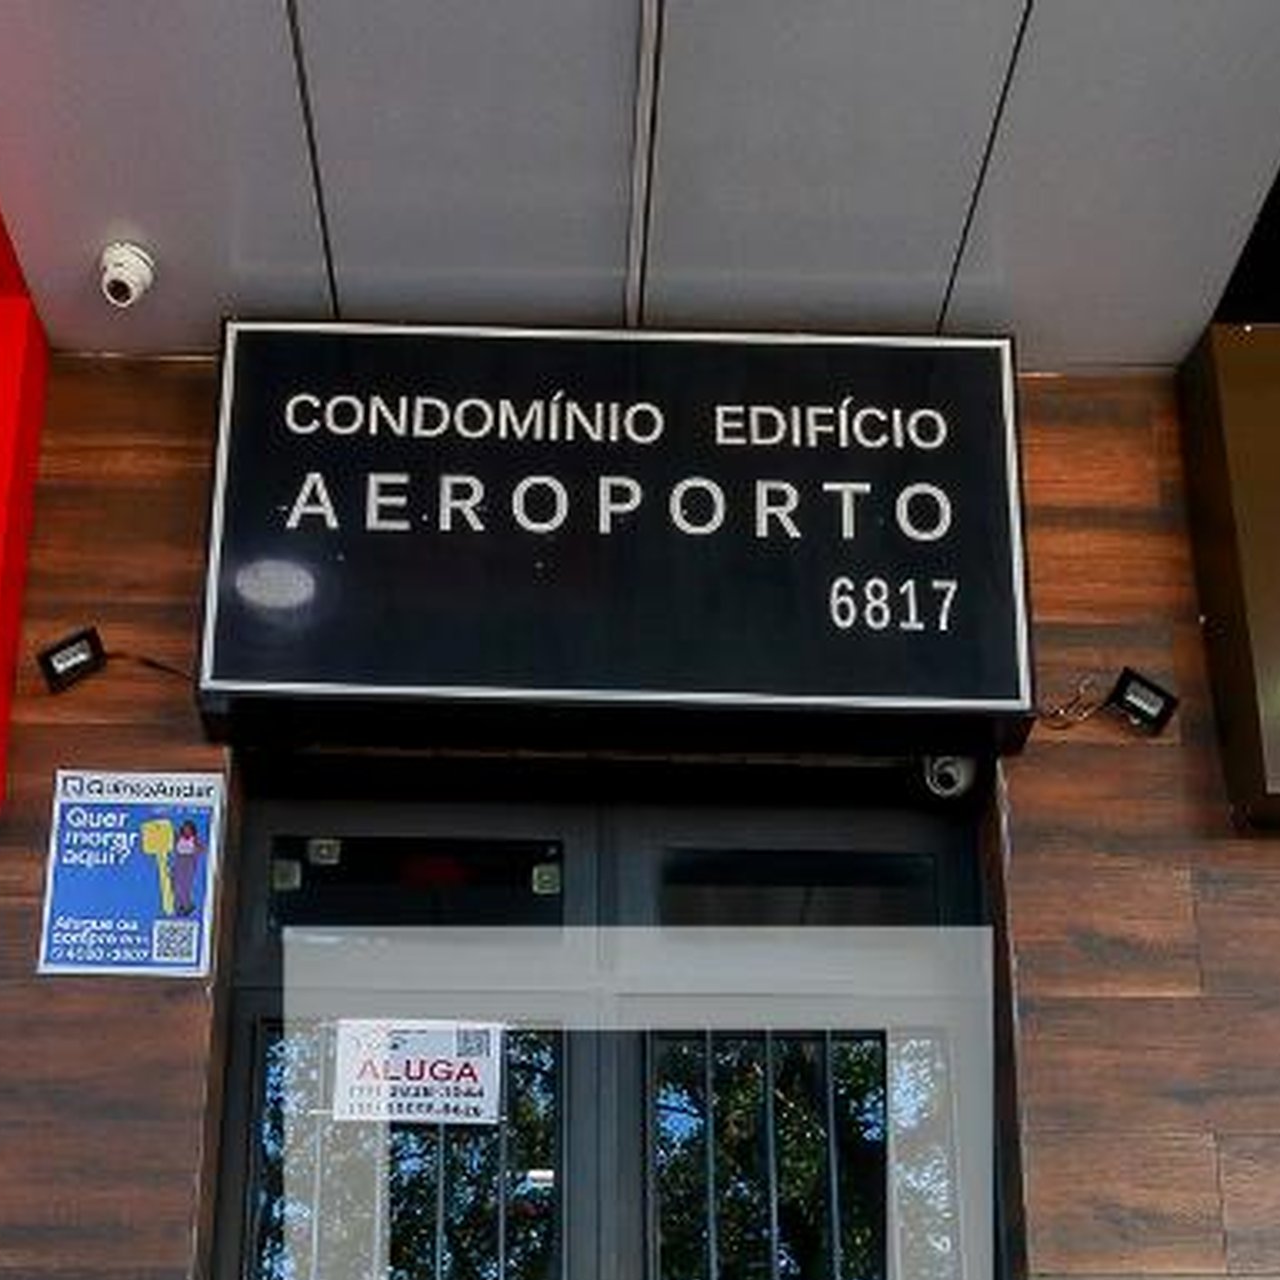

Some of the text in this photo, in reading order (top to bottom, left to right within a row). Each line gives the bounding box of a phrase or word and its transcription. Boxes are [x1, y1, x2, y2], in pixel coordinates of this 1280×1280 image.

[284, 390, 948, 450] CONDOMÍNIO EDIFÍCIO
[285, 471, 954, 541] AEROPORTO
[829, 576, 959, 632] 6817
[66, 807, 129, 828] Quer
[63, 831, 139, 848] morar
[61, 848, 132, 868] aqui?
[356, 1058, 478, 1082] ALUGA
